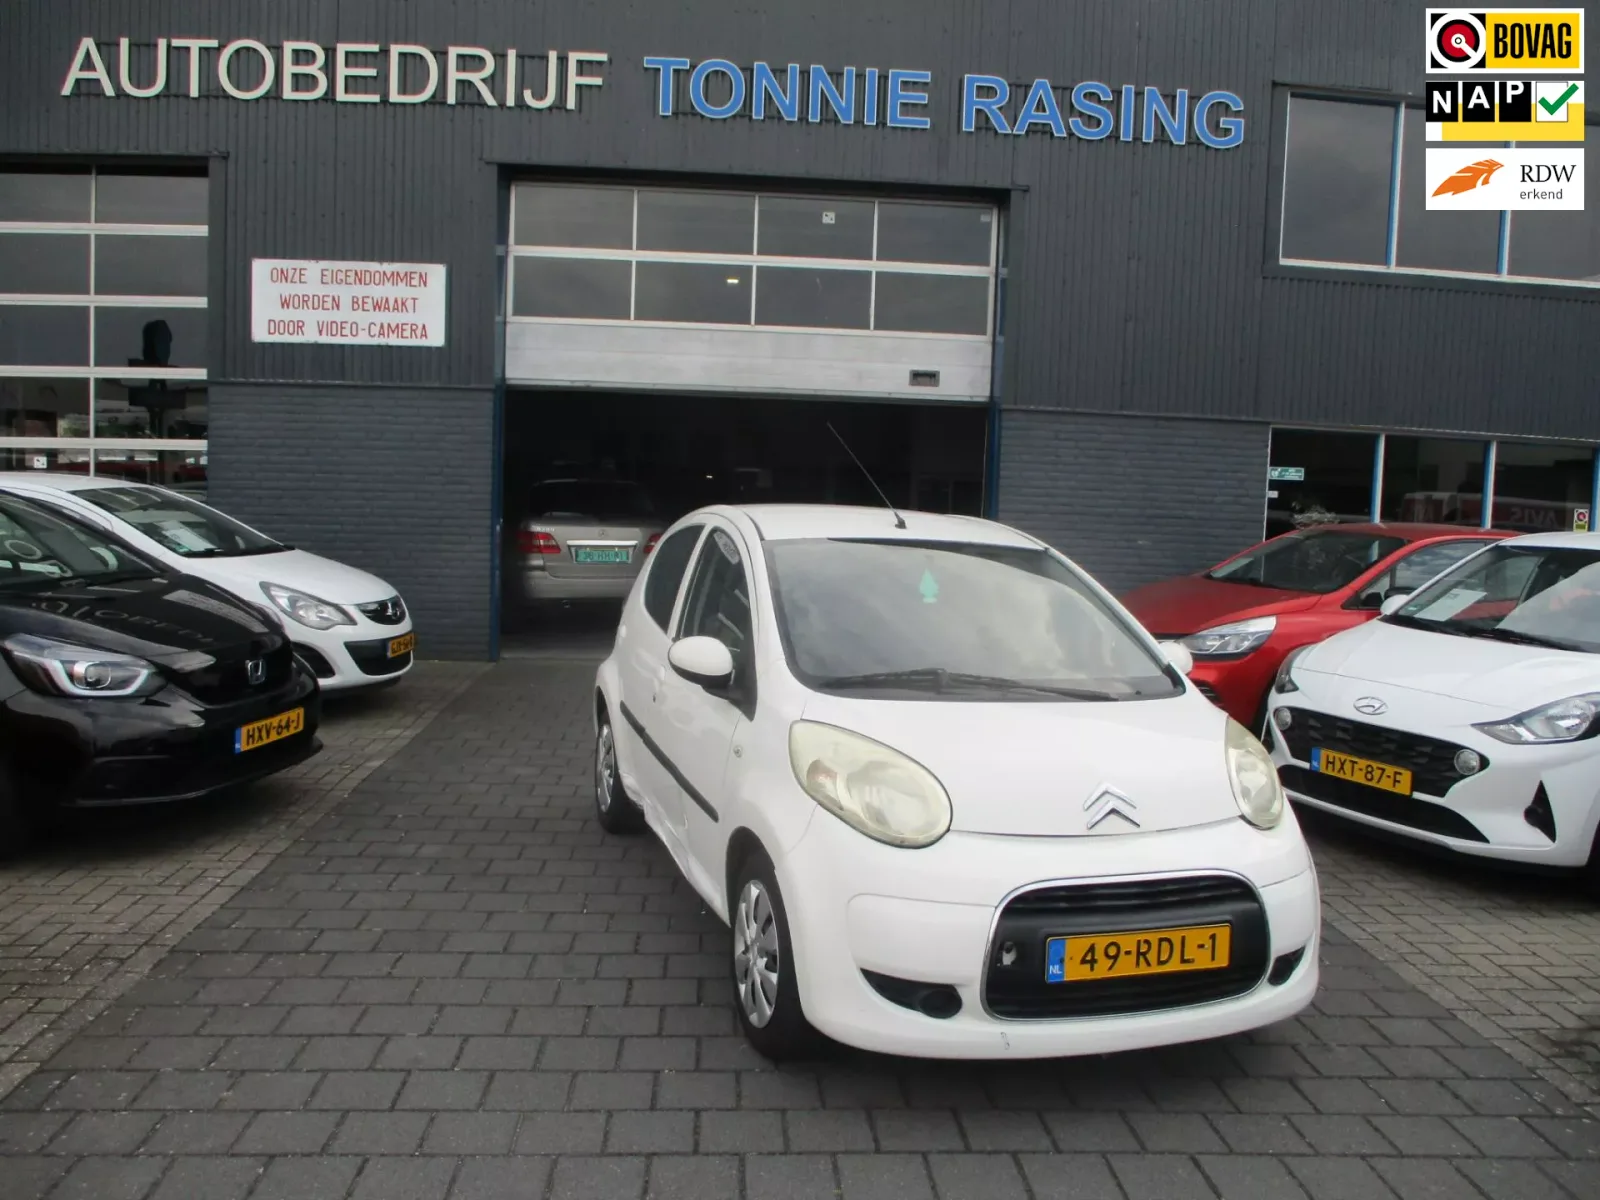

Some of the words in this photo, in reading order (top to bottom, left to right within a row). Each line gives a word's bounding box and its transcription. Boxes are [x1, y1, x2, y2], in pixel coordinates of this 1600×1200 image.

[60, 37, 609, 110] AUTOBEDRIJF
[643, 55, 932, 129] TONNIE
[962, 73, 1246, 150] RASING
[270, 267, 308, 284] ONZE
[320, 268, 428, 288] EIGENDOMMEN
[279, 293, 341, 311] WORDEN
[351, 295, 419, 314] BEWAAKT
[267, 319, 306, 336] DOOR
[316, 320, 429, 340] VIDEO-CAMERA
[246, 712, 301, 746] HXV-64-J
[1325, 754, 1403, 787] HXT-87-F
[1080, 932, 1217, 972] 49-RDL-1
[1049, 964, 1063, 975] NL
